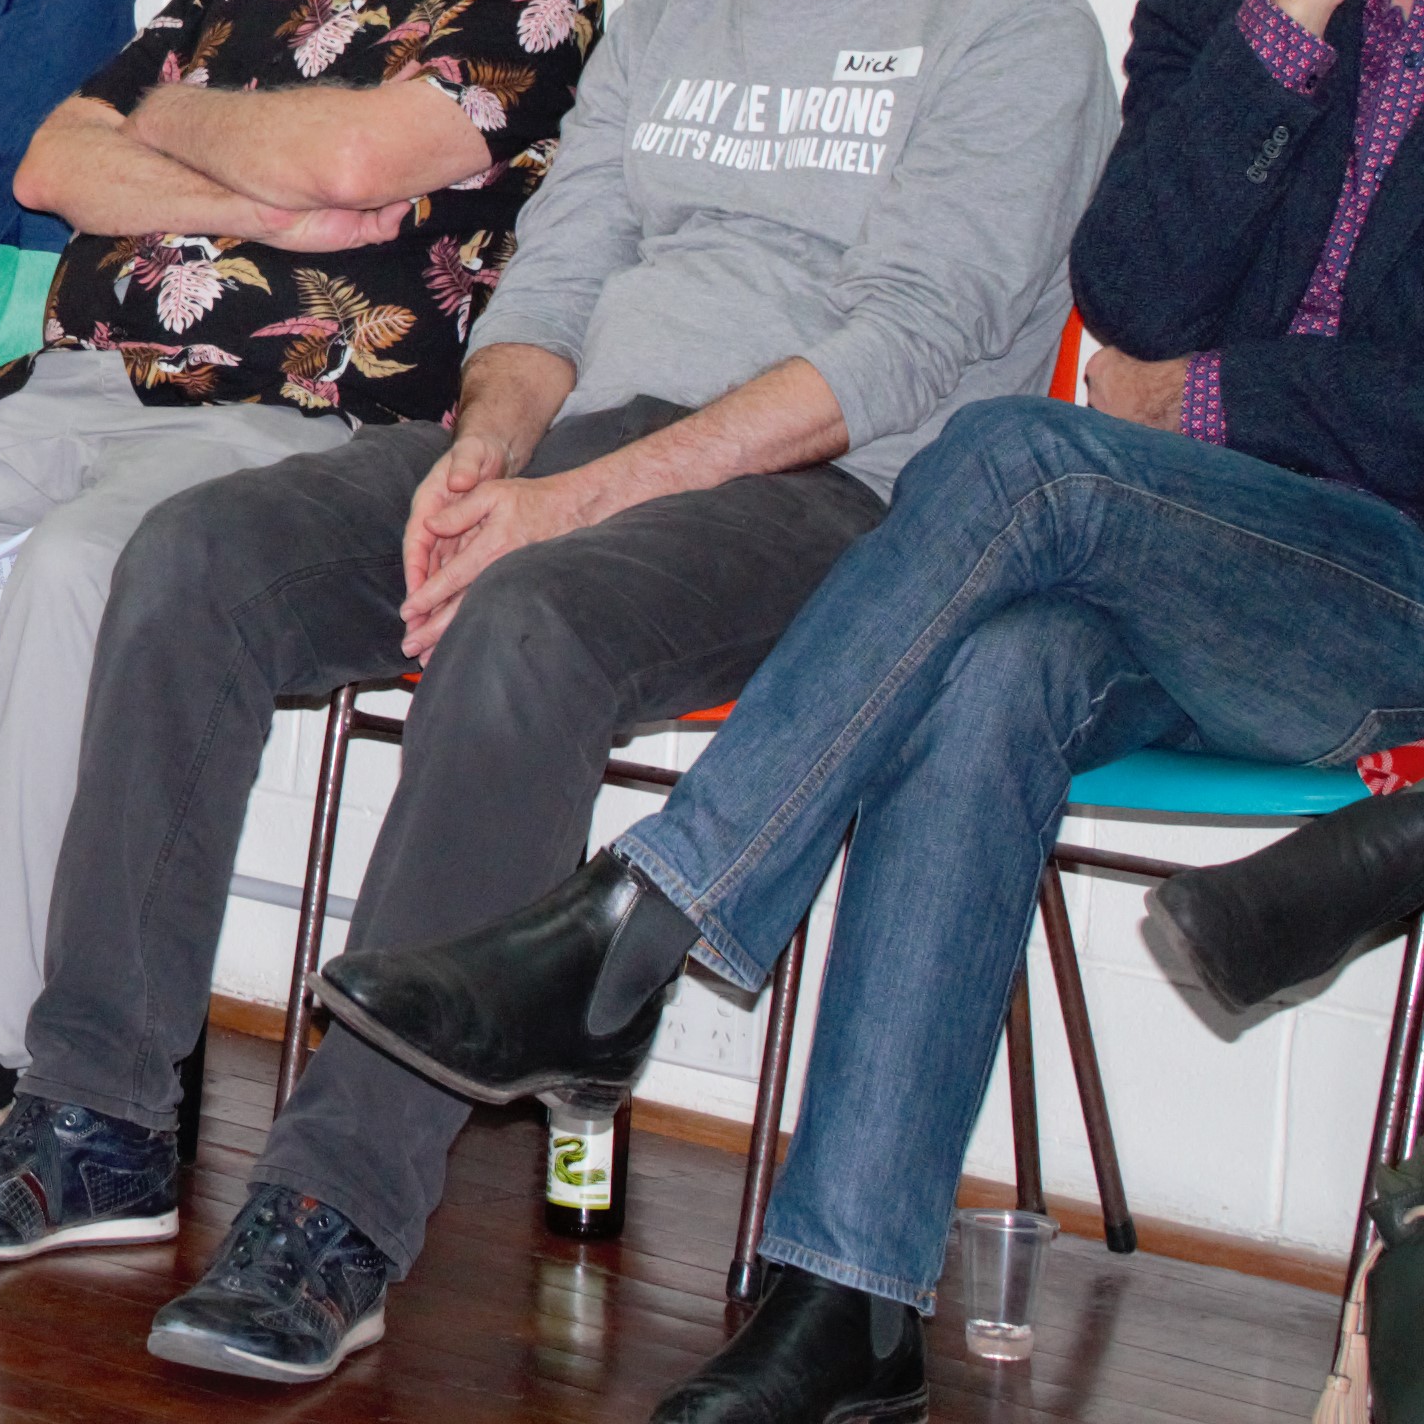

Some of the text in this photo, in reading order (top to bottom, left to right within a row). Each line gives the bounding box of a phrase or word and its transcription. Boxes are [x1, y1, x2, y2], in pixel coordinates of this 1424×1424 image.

[844, 55, 898, 73] Nick
[663, 79, 737, 125] MAY
[778, 86, 895, 138] WRONG
[632, 122, 887, 176] BUT IT'S HIGHLY UNLIKELY
